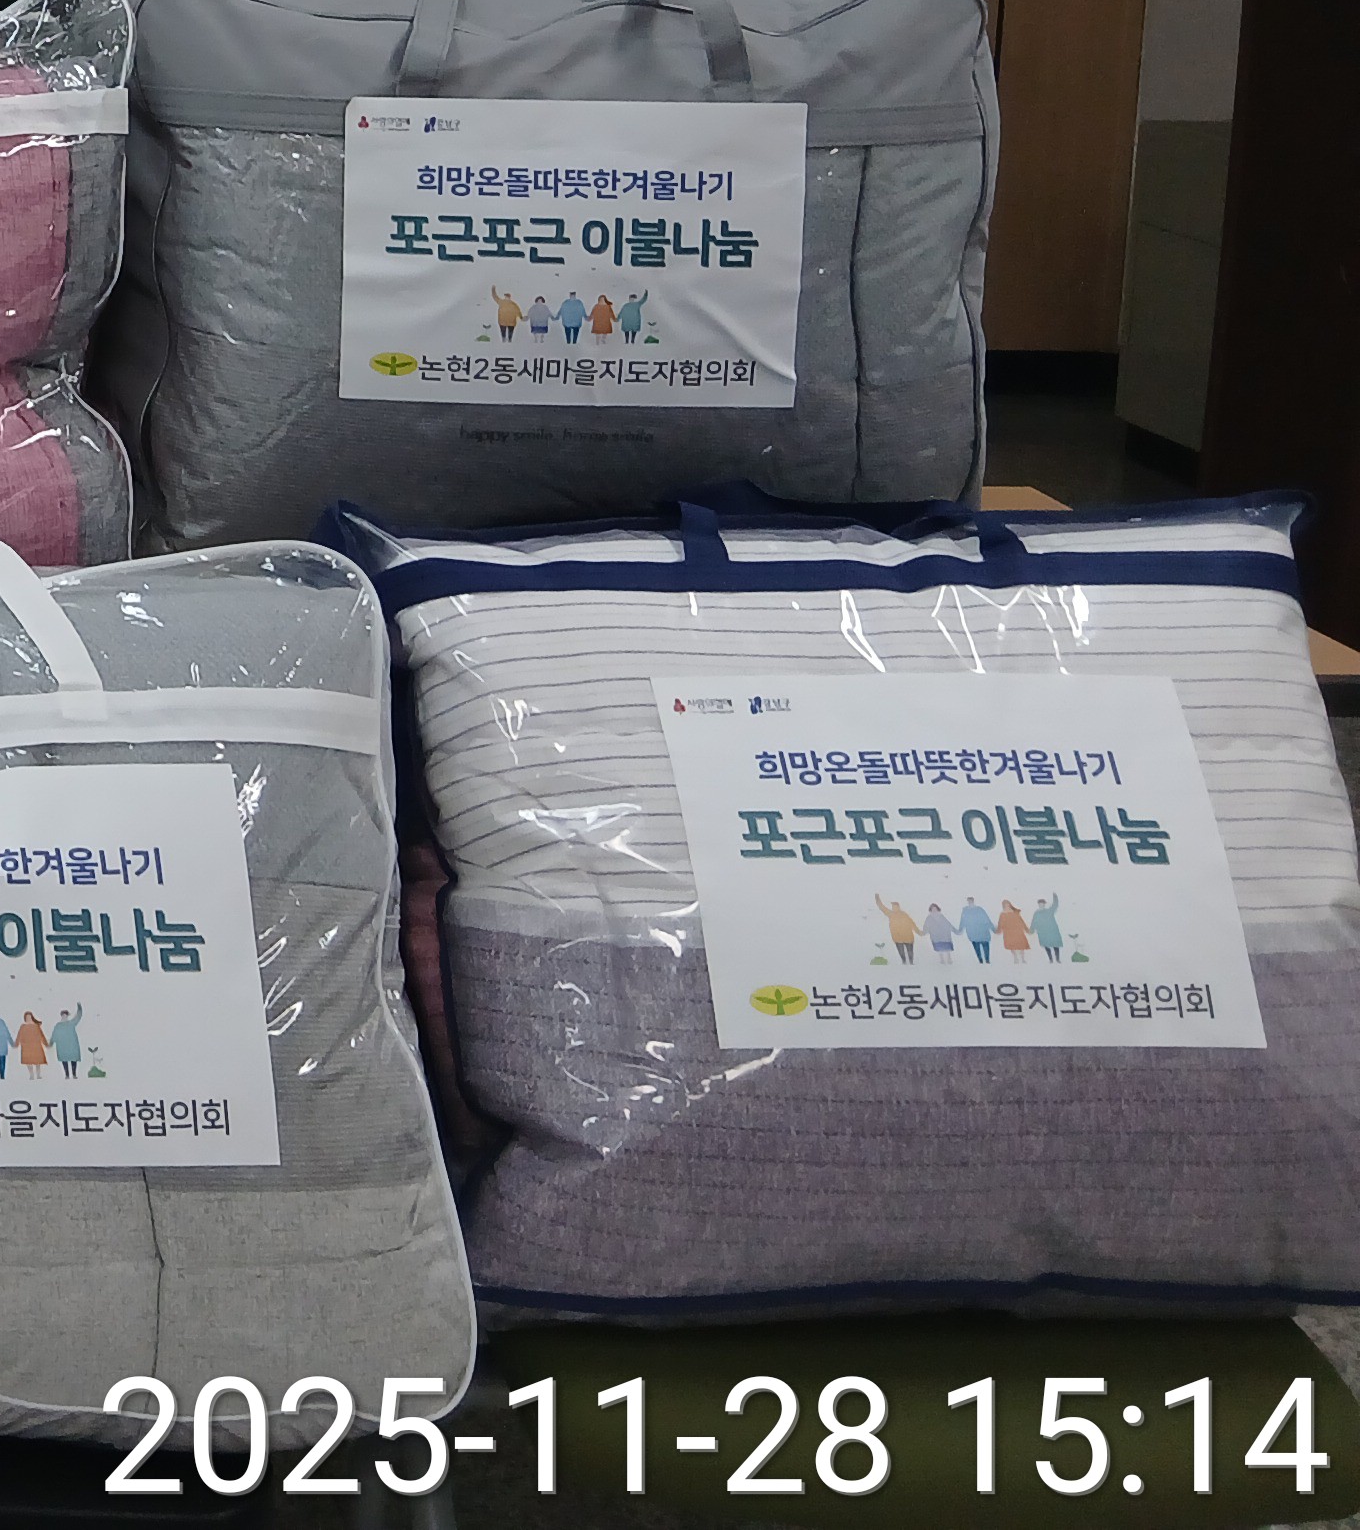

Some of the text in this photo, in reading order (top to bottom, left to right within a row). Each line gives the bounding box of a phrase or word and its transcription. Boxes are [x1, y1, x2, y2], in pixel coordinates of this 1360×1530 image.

[417, 165, 732, 200] 희망온돌따뜻한겨울나기
[386, 215, 759, 268] 포근포근 이불나눔
[416, 355, 757, 387] 논현2동새마을지도자협의회
[755, 749, 1121, 785] 희망온돌따뜻한겨울나기
[738, 806, 1170, 865] 포근포근 이불나눔
[810, 983, 1214, 1020] 논현2동새마을지도자협의회
